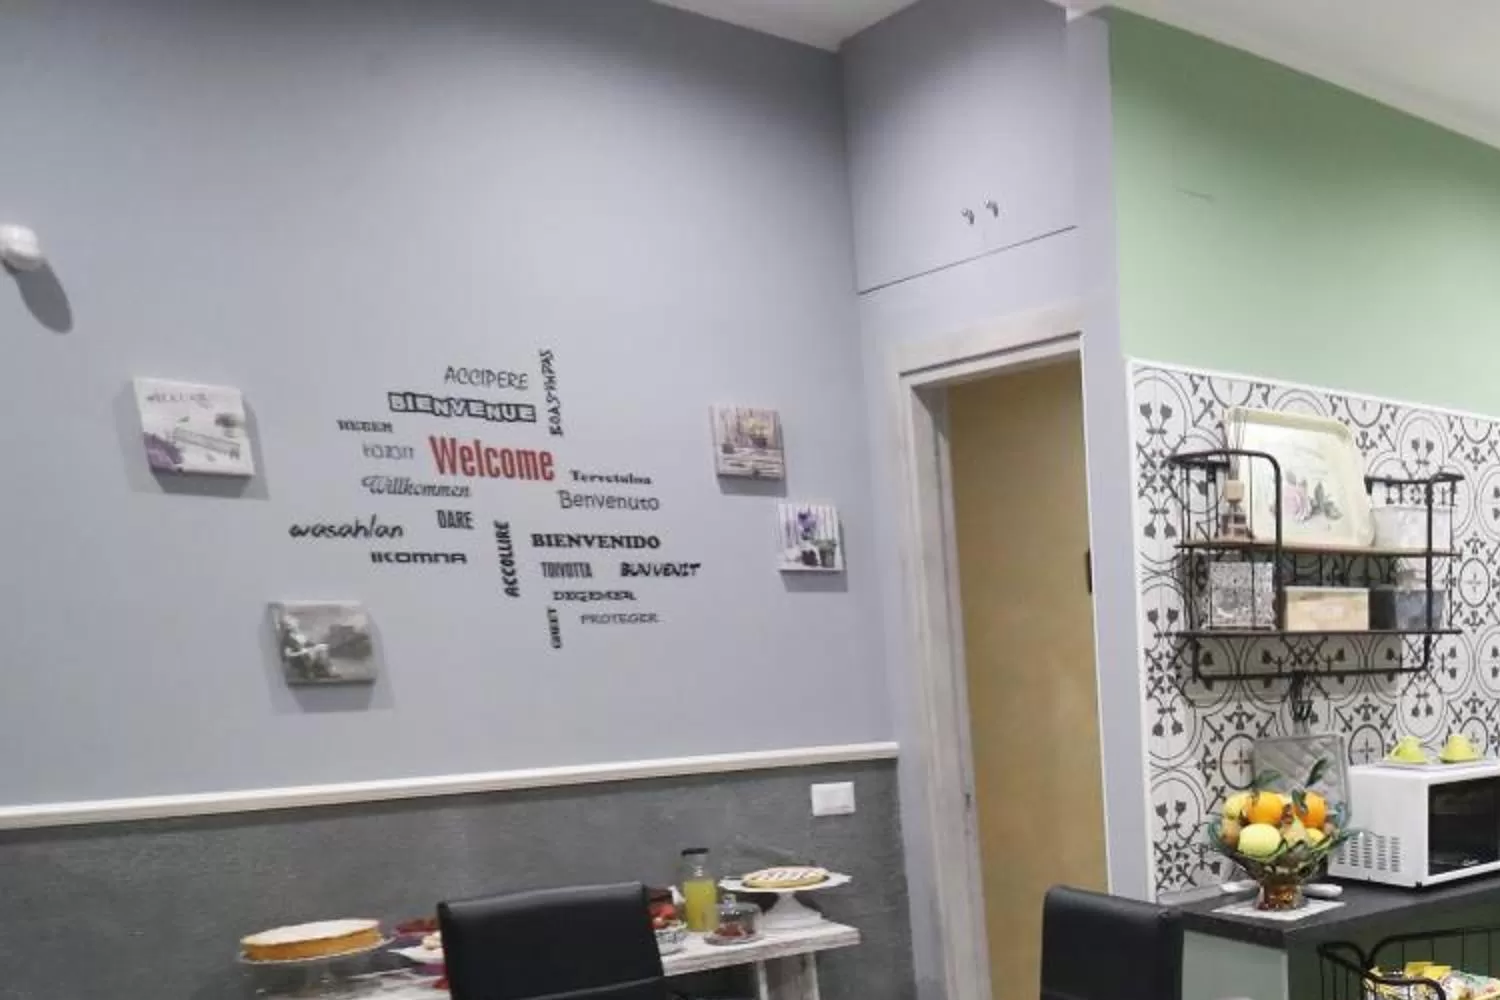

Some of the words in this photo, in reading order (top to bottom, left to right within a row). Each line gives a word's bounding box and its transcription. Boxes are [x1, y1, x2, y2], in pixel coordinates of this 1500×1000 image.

[444, 365, 529, 390] ACCIPERE
[388, 391, 536, 423] BIENVENUE
[429, 435, 555, 481] Welcome
[361, 475, 471, 498] Willkommen
[557, 489, 660, 511] Benvenuto
[436, 509, 475, 530] DARE
[531, 533, 661, 550] BIENVENIDO
